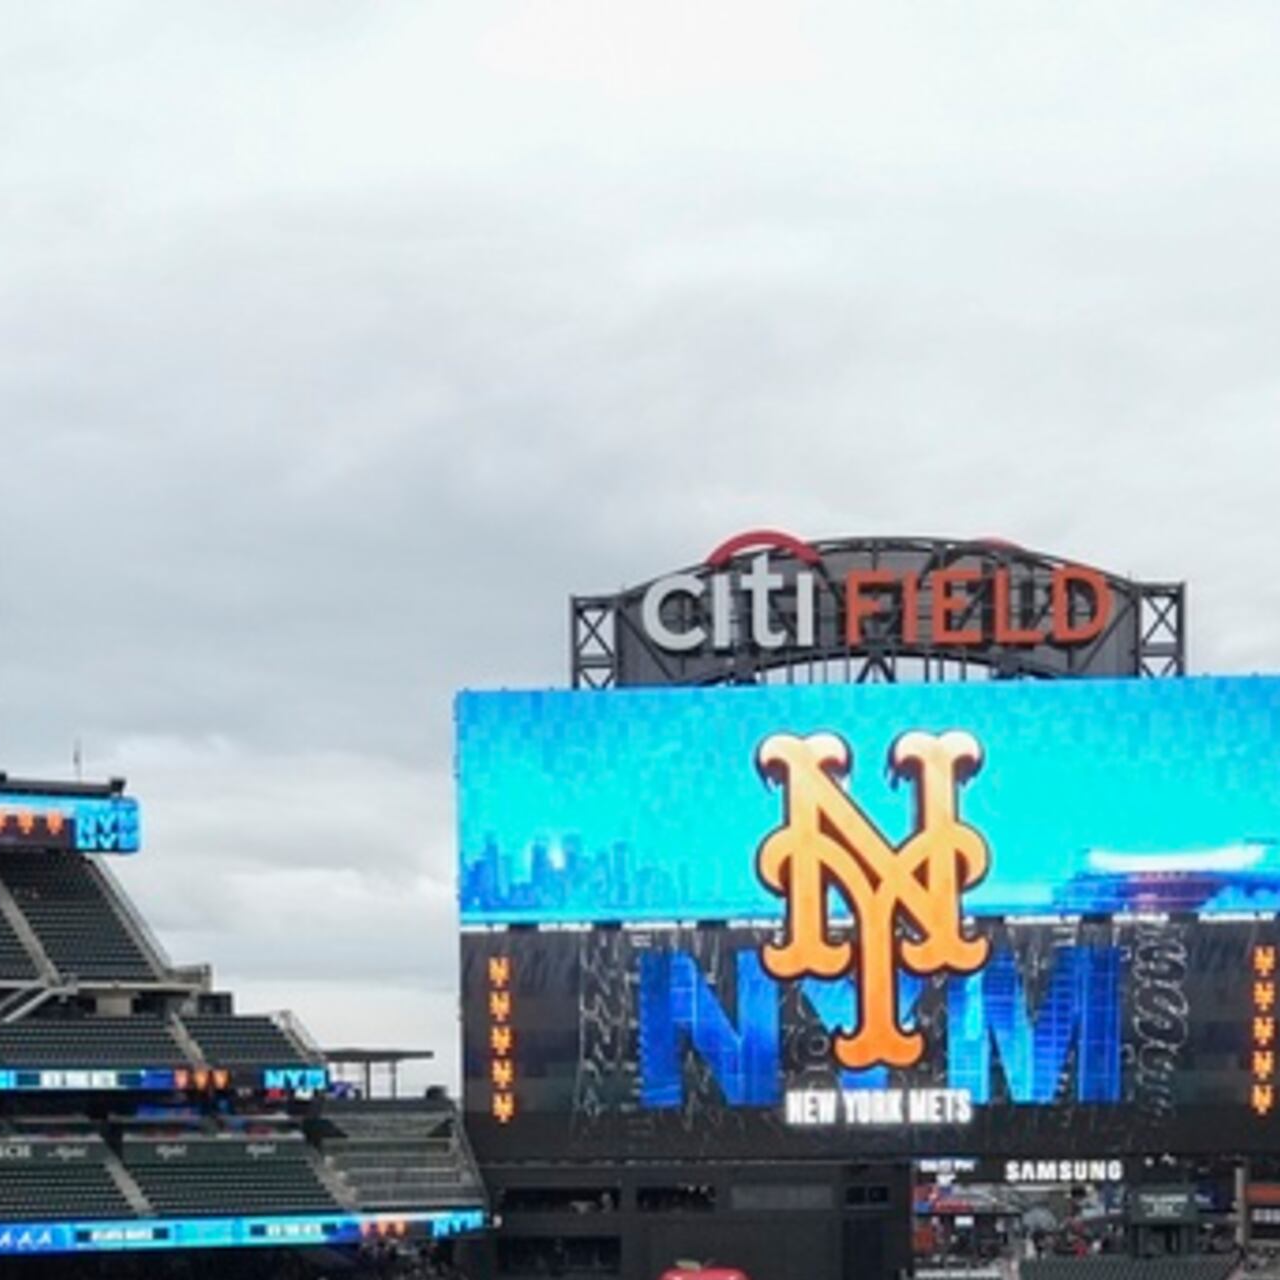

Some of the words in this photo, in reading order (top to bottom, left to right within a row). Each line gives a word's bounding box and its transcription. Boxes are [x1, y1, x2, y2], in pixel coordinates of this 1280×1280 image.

[641, 553, 814, 652] citi
[844, 565, 1113, 647] FIELD
[786, 1090, 837, 1124] NEW
[841, 1090, 904, 1124] YORK
[908, 1090, 971, 1124] METS
[1004, 1159, 1122, 1182] SAMSUNG
